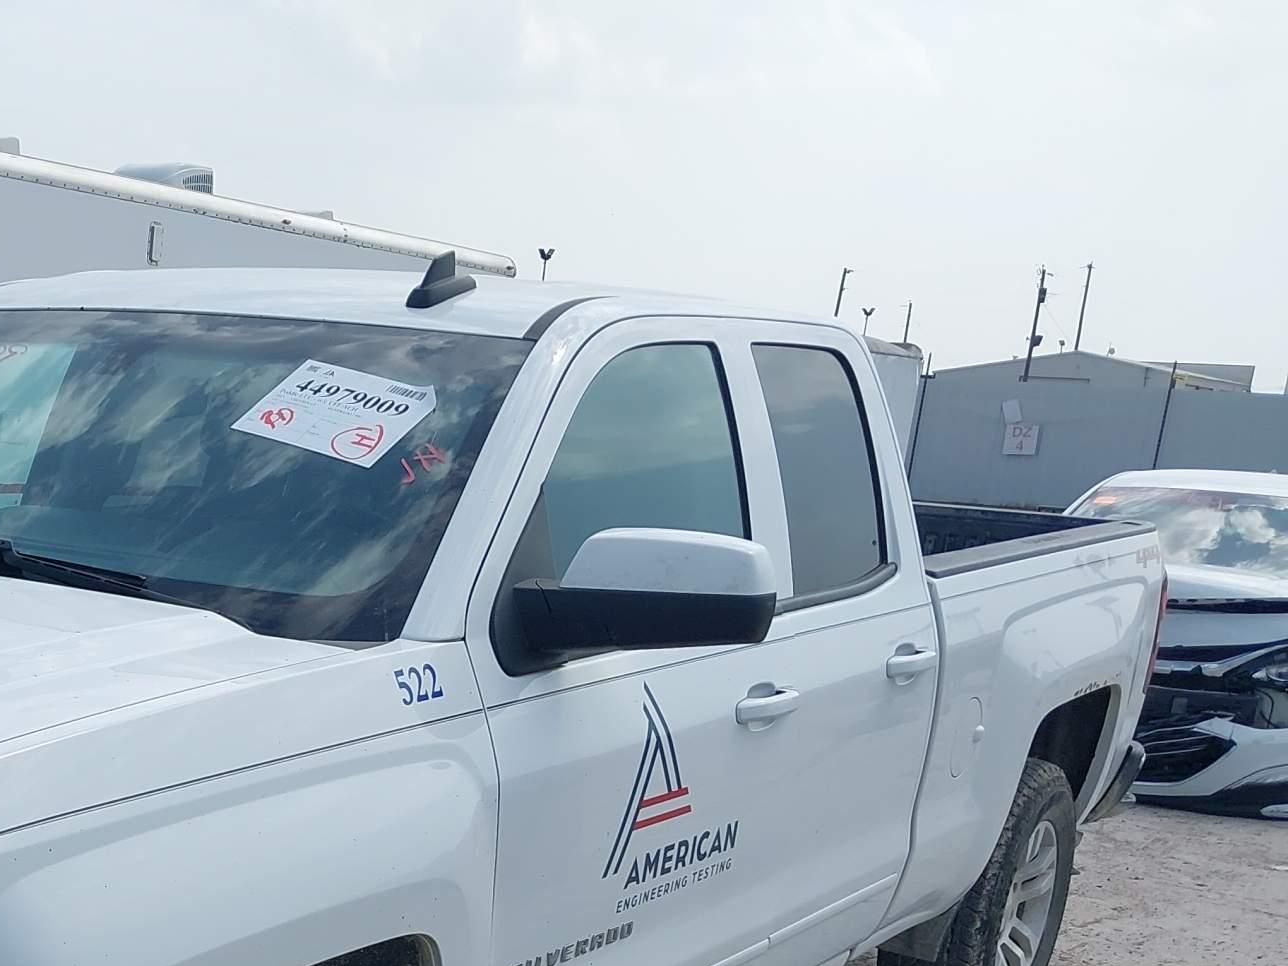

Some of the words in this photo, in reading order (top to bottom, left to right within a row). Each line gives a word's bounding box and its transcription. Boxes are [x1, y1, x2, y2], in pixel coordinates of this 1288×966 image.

[295, 379, 410, 417] 44979009
[1015, 440, 1024, 451] 4
[394, 663, 443, 705] 522
[623, 820, 739, 890] AMERICAN
[615, 874, 689, 914] ENGINEERING
[691, 856, 733, 885] TESTING
